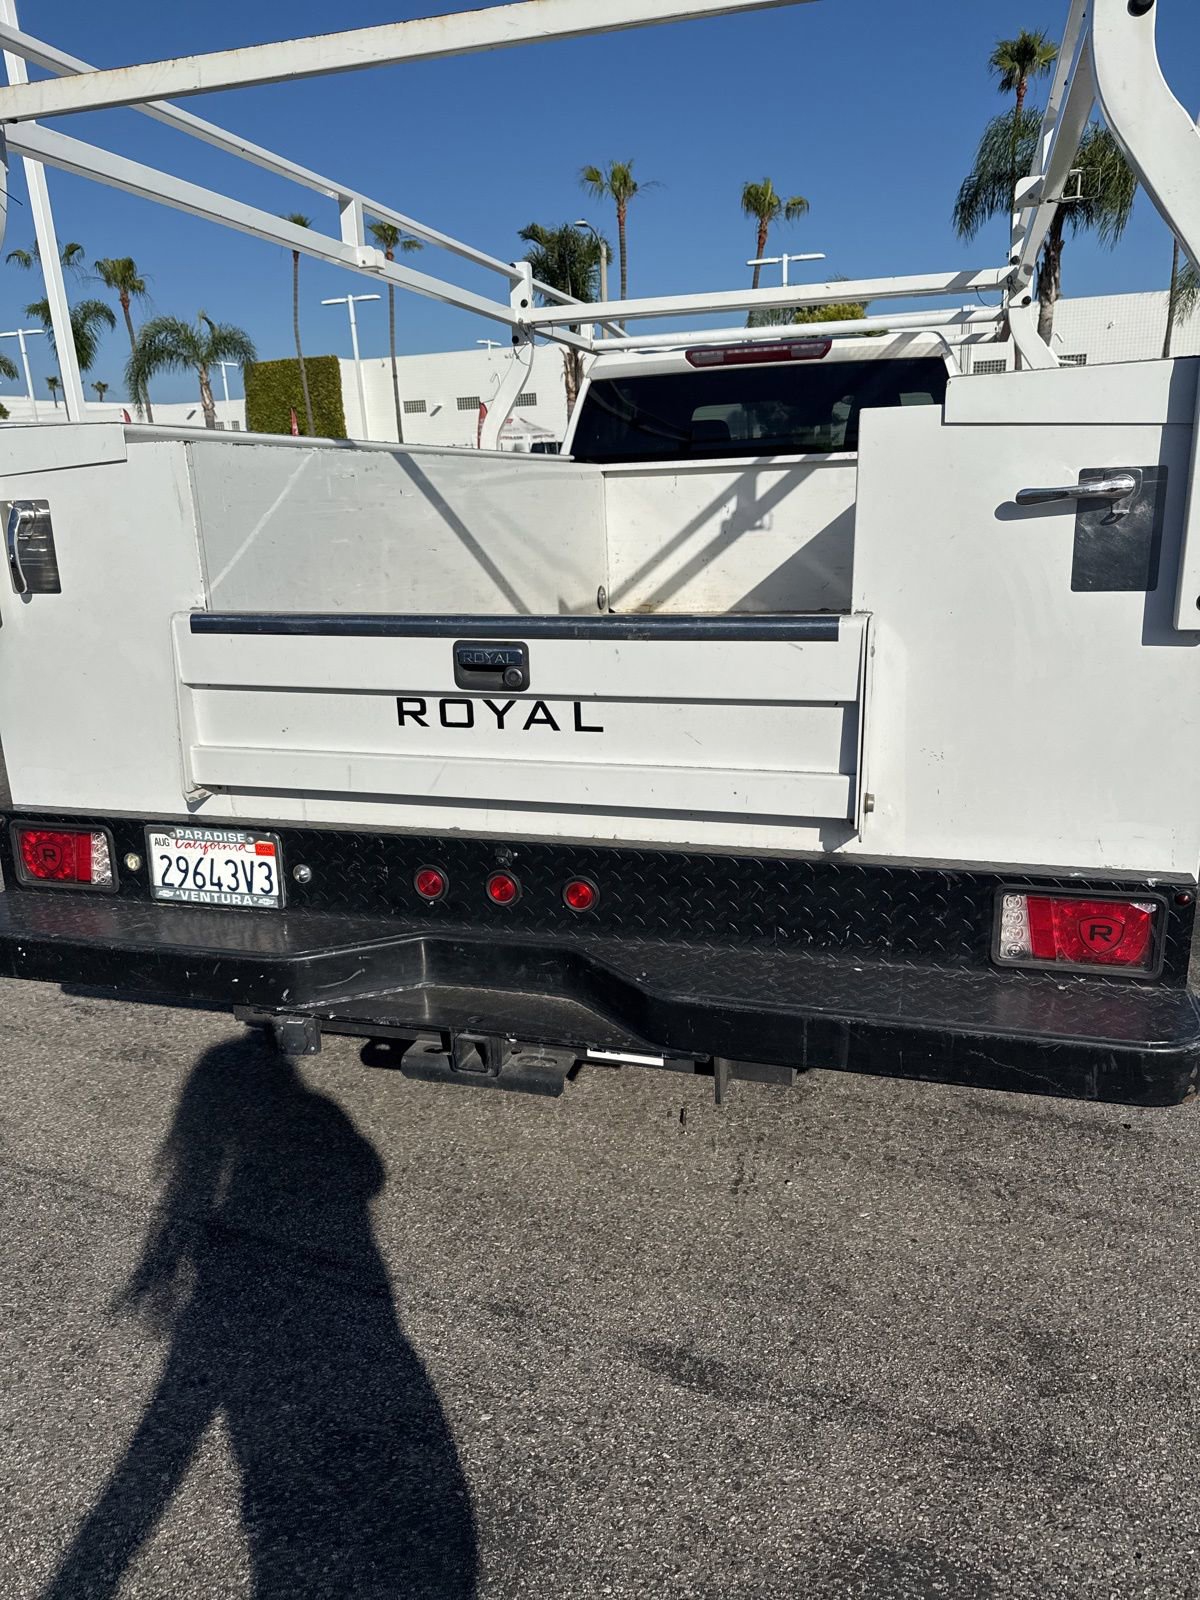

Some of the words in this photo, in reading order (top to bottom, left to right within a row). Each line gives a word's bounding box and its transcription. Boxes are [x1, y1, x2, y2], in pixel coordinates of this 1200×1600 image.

[463, 652, 515, 664] ROYAL
[396, 697, 604, 732] ROYAL
[154, 837, 170, 847] AUG
[176, 829, 245, 842] PARADISE
[43, 848, 56, 862] R
[175, 839, 247, 855] California
[160, 854, 274, 895] 29643V3
[180, 888, 254, 905] VENTURA
[1090, 924, 1113, 943] R
